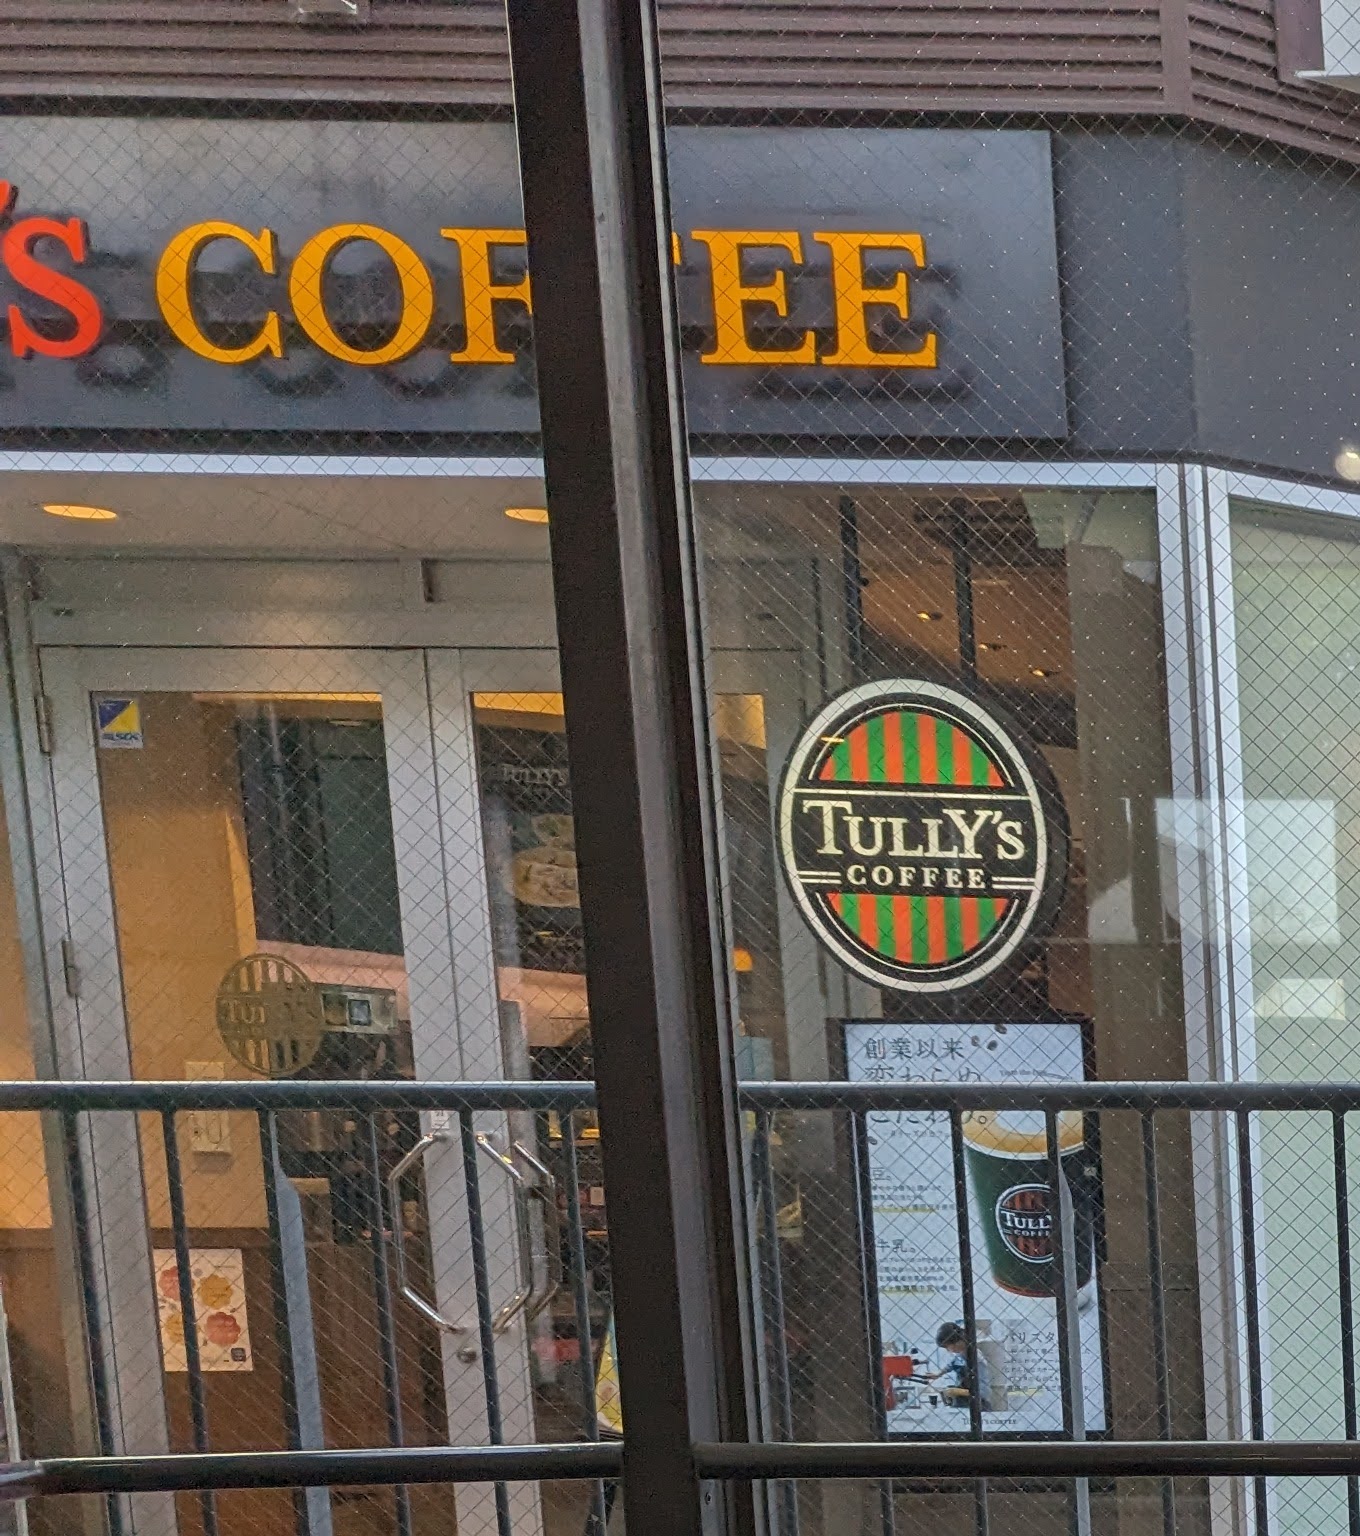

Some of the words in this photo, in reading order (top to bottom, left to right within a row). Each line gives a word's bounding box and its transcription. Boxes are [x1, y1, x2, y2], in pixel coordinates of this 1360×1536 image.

[155, 221, 939, 369] COFEE
[801, 798, 1026, 862] TULLY'S
[846, 864, 987, 889] COFFEE
[864, 1037, 965, 1061] 創業以来
[1000, 1210, 1053, 1229] TULL
